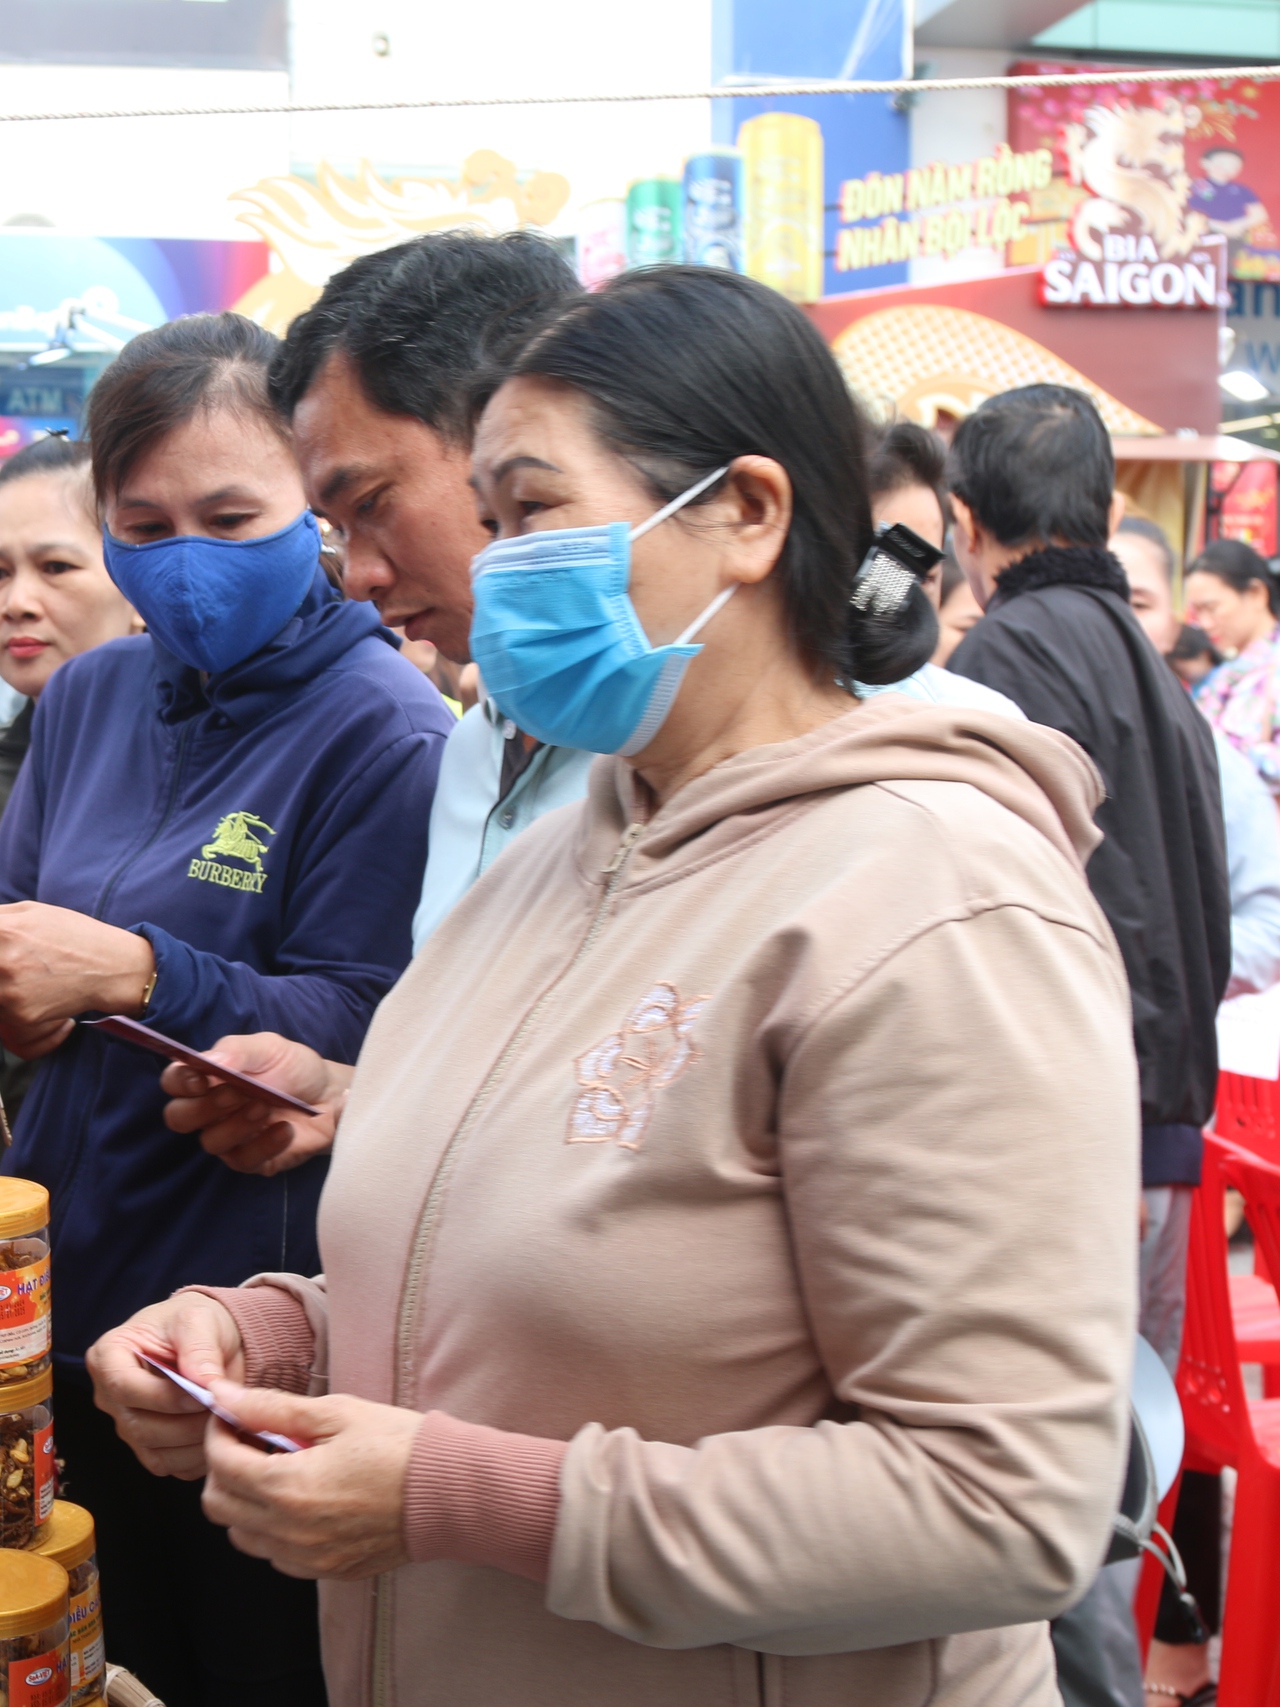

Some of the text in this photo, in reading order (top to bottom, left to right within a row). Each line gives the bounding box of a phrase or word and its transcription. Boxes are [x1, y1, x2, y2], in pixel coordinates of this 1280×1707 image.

[1104, 234, 1159, 262] BIA
[1043, 259, 1217, 306] SAIGON
[6, 387, 62, 412] ATM
